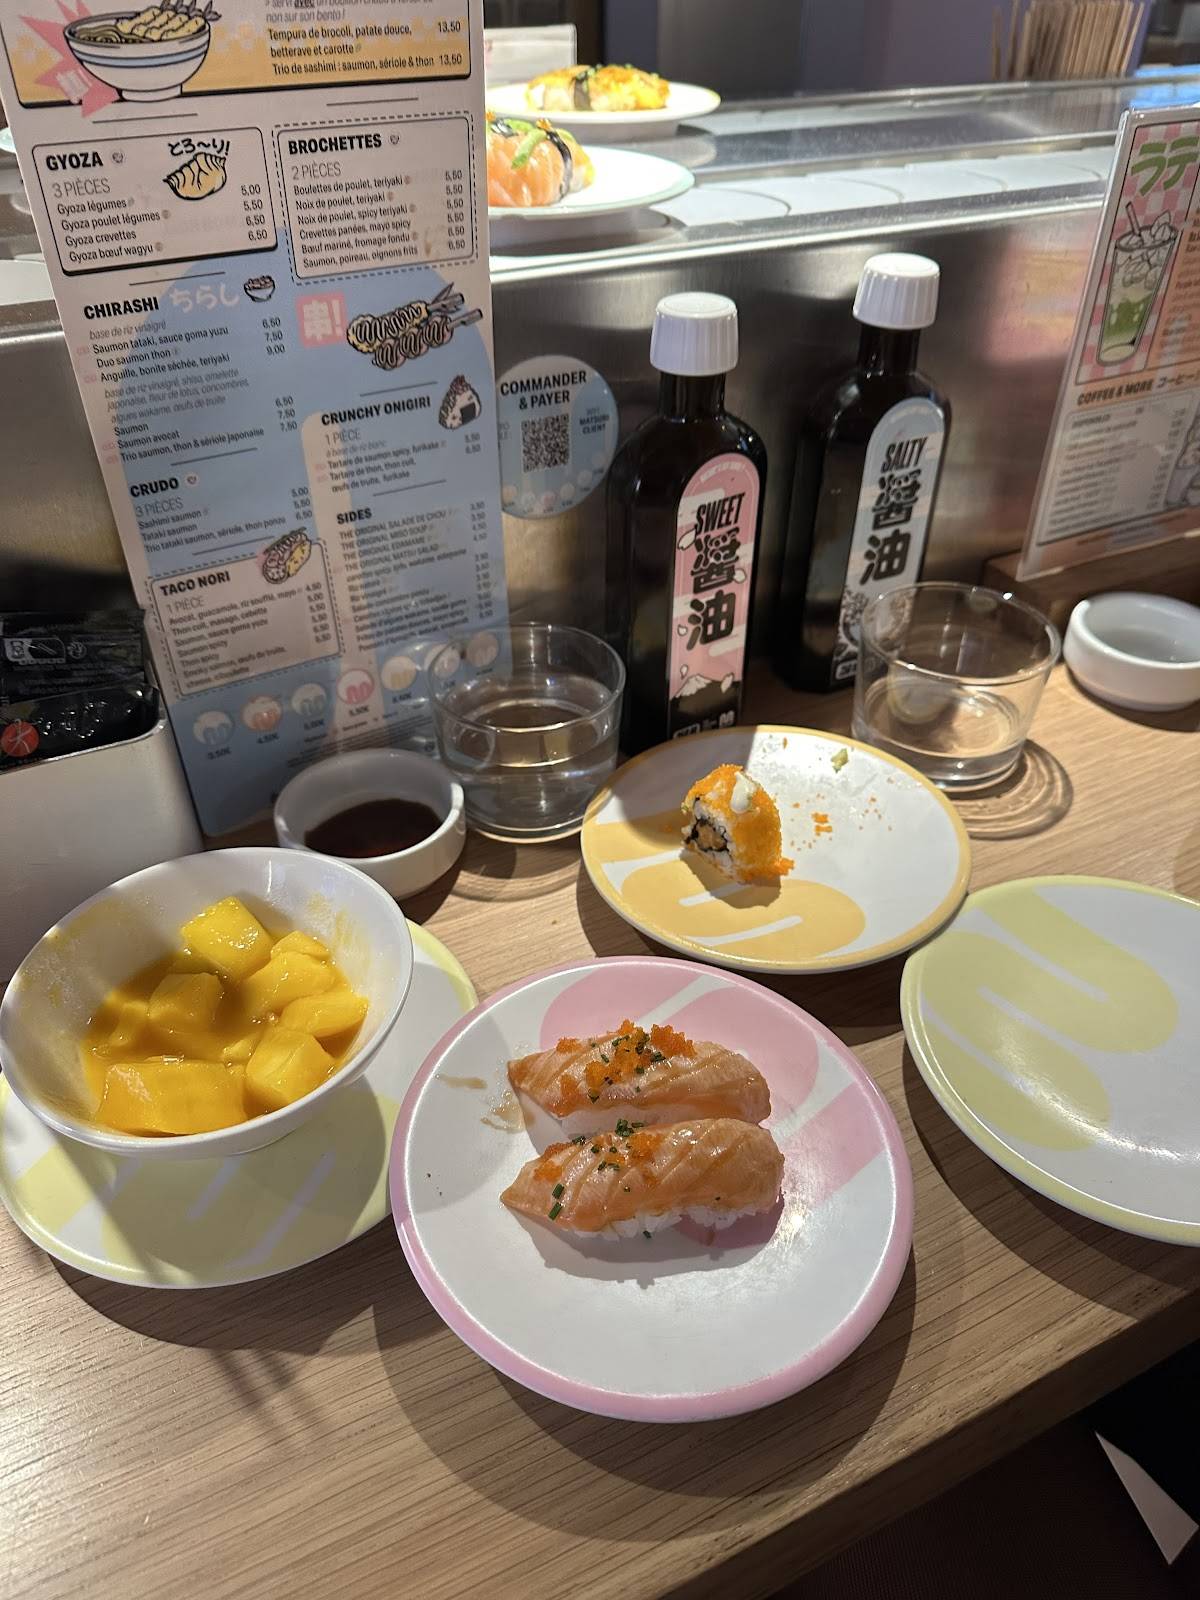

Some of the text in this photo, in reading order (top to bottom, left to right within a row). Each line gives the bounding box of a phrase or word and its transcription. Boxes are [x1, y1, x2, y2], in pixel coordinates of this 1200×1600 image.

[269, 27, 306, 43] Tempura
[308, 27, 320, 38] de
[355, 26, 382, 40] patate
[383, 25, 412, 36] douce,
[271, 43, 354, 58] betterave et carotte
[272, 62, 289, 75] Trio
[291, 62, 302, 74] de
[303, 60, 337, 73] sashimi
[342, 60, 377, 72] saumon,
[379, 56, 407, 69] sériole
[407, 57, 414, 67] &
[415, 56, 435, 67] thon
[288, 133, 382, 155] BROCHETTES
[45, 151, 103, 172] GYOZA
[292, 160, 341, 180] 2 PIÈCES
[1129, 135, 1200, 197] ラテ
[53, 177, 110, 198] 3 PIÈCES
[293, 182, 332, 196] Boulettes
[333, 182, 344, 192] de
[344, 178, 373, 191] poulet,
[374, 175, 403, 189] teriyaki
[57, 203, 86, 217] Gyoza
[88, 198, 127, 214] légumes
[295, 199, 315, 211] Noix
[316, 198, 326, 208] de
[327, 194, 355, 207] poulet,
[356, 190, 386, 204] teriyaki
[61, 219, 90, 233] Gyoza
[91, 214, 120, 230] poulet
[122, 210, 161, 227] légumes
[297, 213, 317, 225] Noix
[320, 212, 329, 222] de
[358, 206, 379, 220] spicy
[379, 204, 408, 217] teriyaki
[65, 234, 94, 248] Gyoza
[95, 229, 137, 243] crevettes
[299, 226, 336, 240] Crevettes
[369, 221, 390, 233] mayo
[391, 219, 411, 231] spicy
[354, 236, 386, 249] fromage
[387, 233, 410, 244] fondu
[69, 250, 98, 265] Gyoza
[125, 243, 153, 258] wagyu
[303, 256, 337, 269] Saumon,
[339, 252, 370, 265] poireau,
[371, 248, 402, 262] oignons
[403, 247, 418, 256] frits
[83, 297, 159, 320] CHIRASHI
[169, 282, 240, 314] ちらし
[92, 342, 128, 354] Saumon
[130, 336, 157, 349] tataki,
[158, 334, 183, 345] sauce
[184, 332, 208, 344] goma
[209, 326, 229, 338] yuzu
[96, 358, 115, 369] Duo
[116, 353, 150, 365] saumon
[151, 349, 171, 361] thon
[139, 363, 167, 376] bonite
[200, 353, 230, 367] teriyaki
[500, 370, 587, 397] COMMANDER
[321, 395, 432, 426] CRUNCHY ONIGIRI
[518, 389, 570, 411] & PAYER
[114, 423, 149, 436] Saumon
[117, 438, 152, 450] Saumon
[153, 430, 181, 442] avocat
[121, 452, 138, 463] Trio
[139, 446, 173, 459] saumon,
[173, 441, 193, 453] thon
[193, 439, 200, 448] &
[227, 428, 265, 444] japonaise
[880, 436, 928, 474] SALTY
[129, 477, 180, 499] CRUDO
[135, 505, 143, 517] 3
[171, 509, 202, 522] saumon
[336, 507, 372, 525] SIDES
[693, 492, 746, 537] SWEET
[167, 523, 198, 536] saumon
[160, 571, 231, 597] TACO NORI
